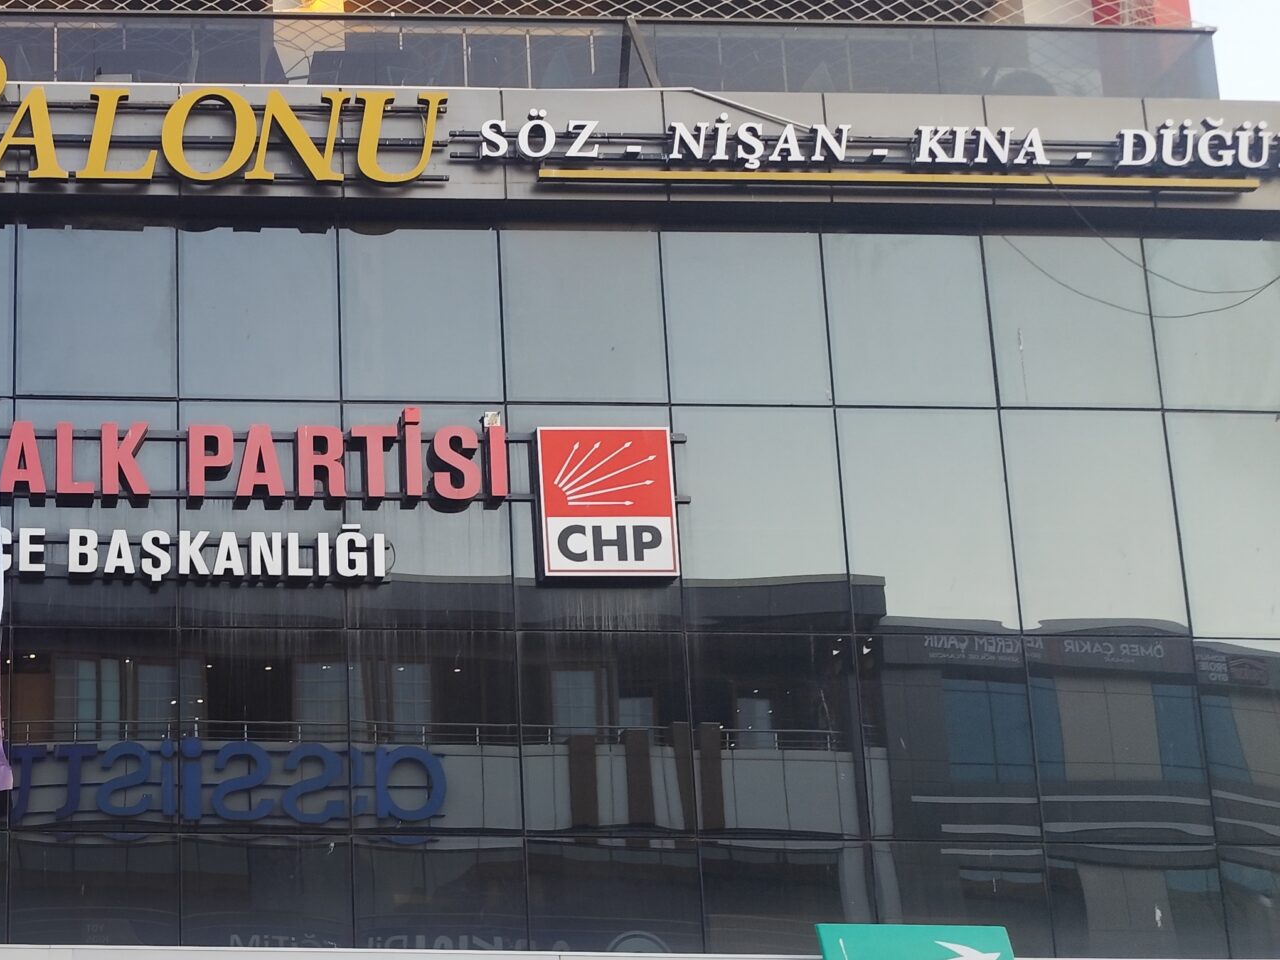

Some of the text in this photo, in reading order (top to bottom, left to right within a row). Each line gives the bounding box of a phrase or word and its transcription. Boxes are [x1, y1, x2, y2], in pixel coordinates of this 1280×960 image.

[481, 108, 600, 159] SÖZ
[669, 112, 852, 170] NİŞAN
[915, 125, 1051, 165] KINA
[1118, 116, 1280, 168] DÜĞÜ
[0, 421, 151, 495] ALK
[68, 523, 386, 582] BAŞKANLIĞI
[556, 524, 662, 562] CHP
